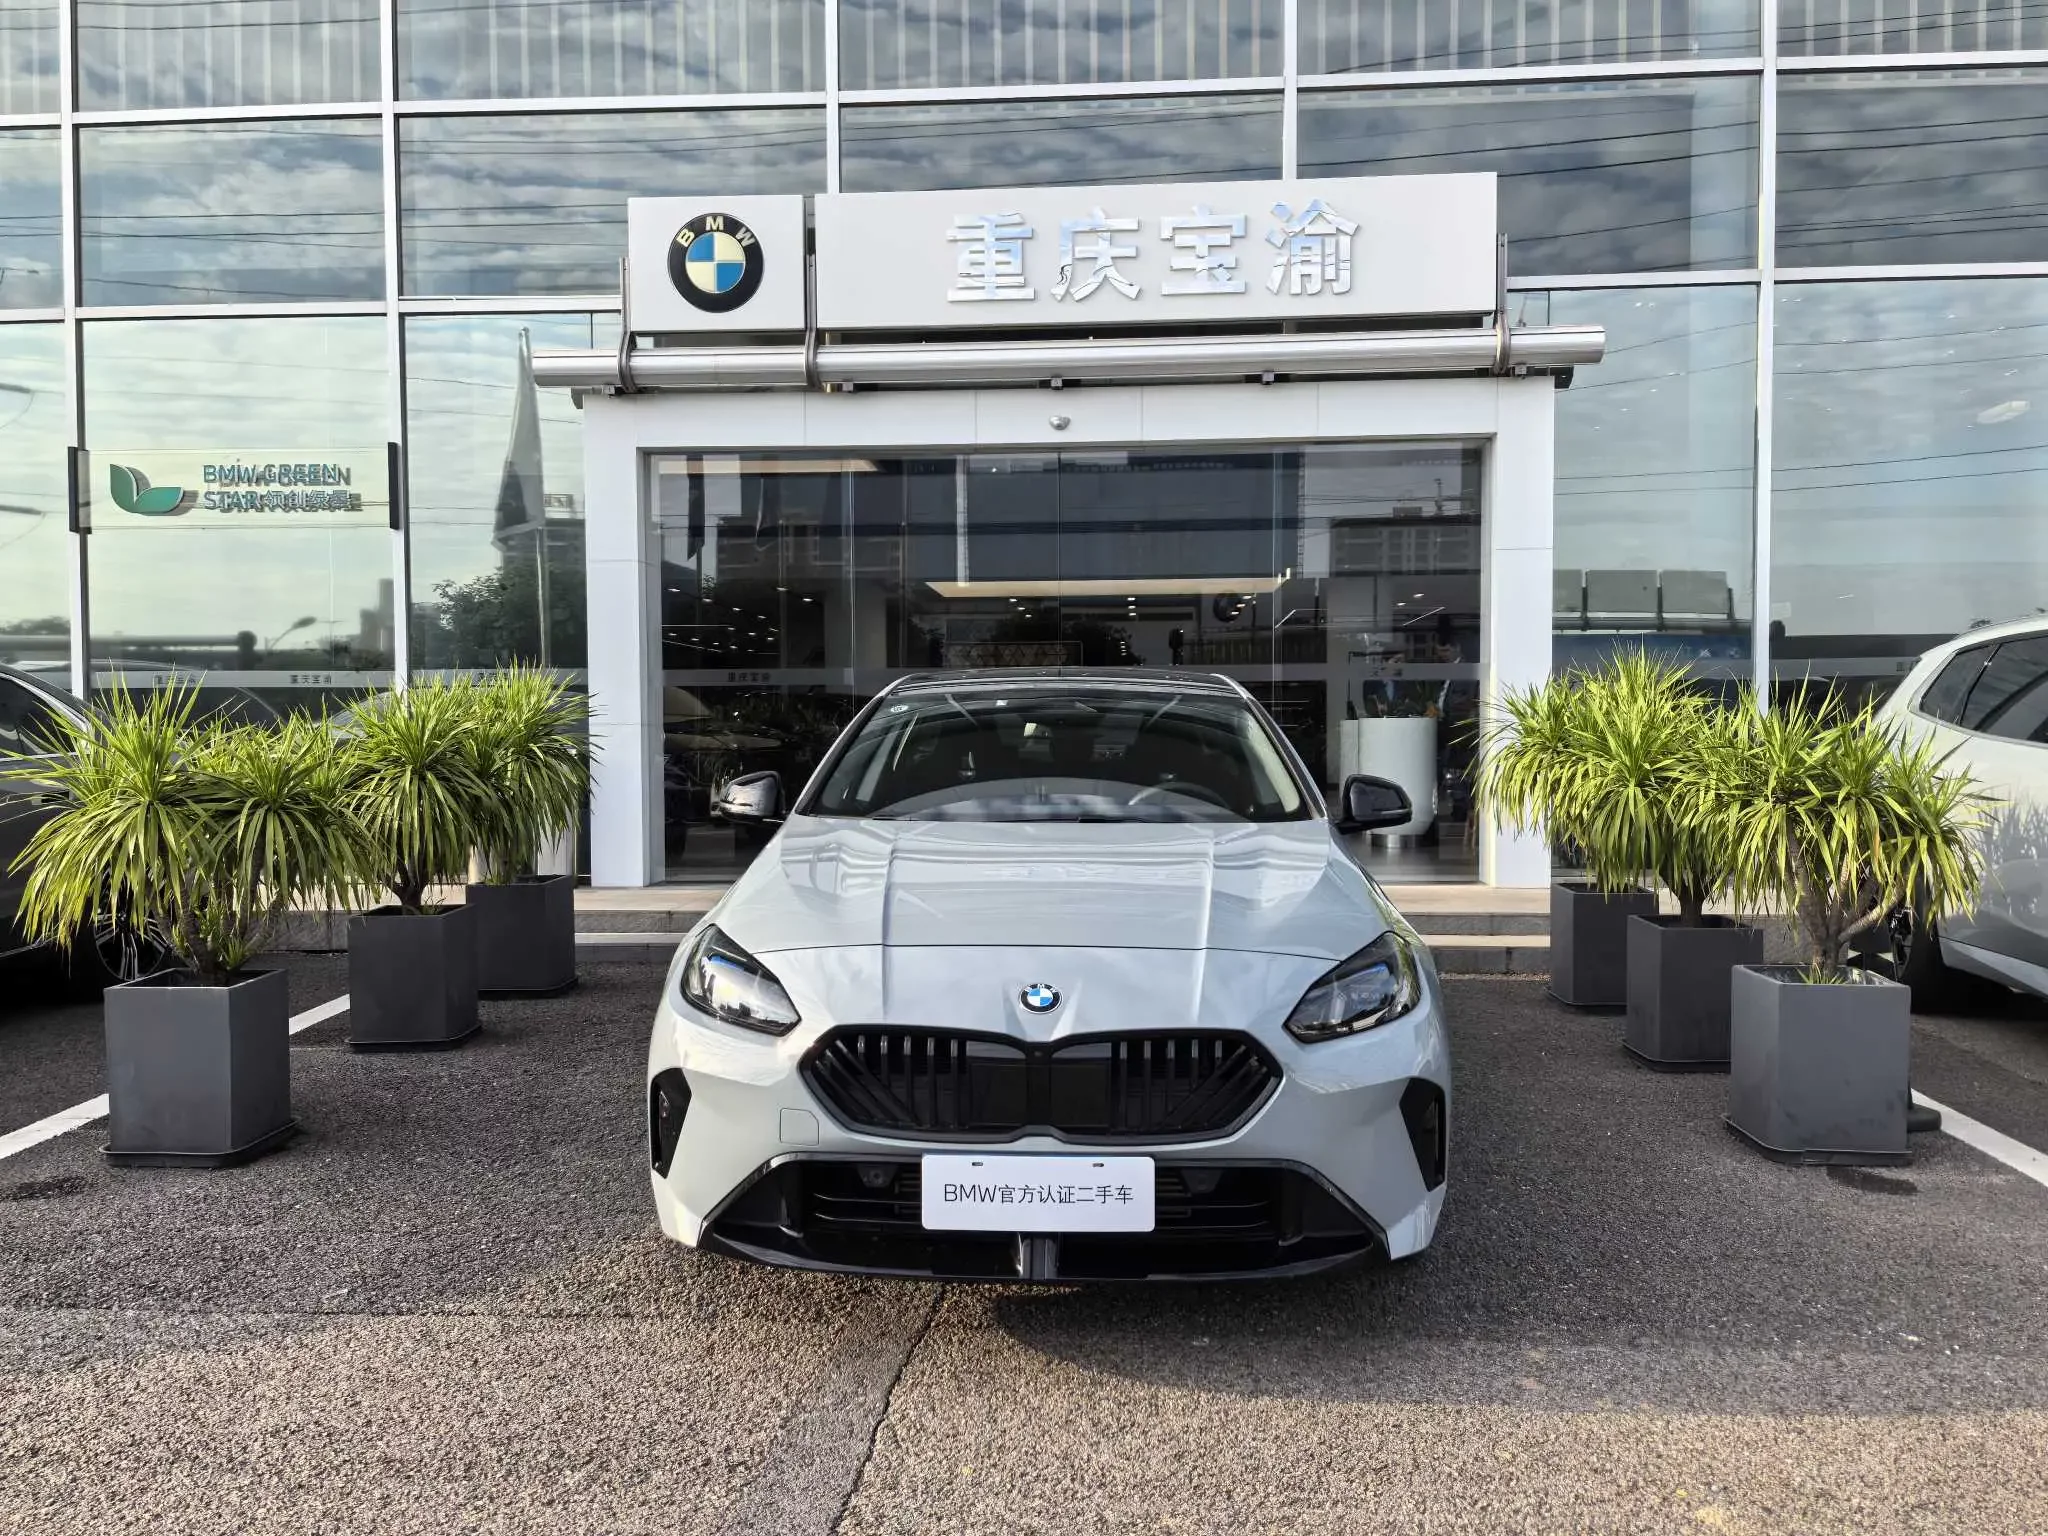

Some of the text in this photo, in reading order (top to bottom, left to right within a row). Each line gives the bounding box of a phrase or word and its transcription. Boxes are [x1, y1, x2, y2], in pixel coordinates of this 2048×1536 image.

[676, 215, 756, 248] BMW
[946, 199, 1361, 302] 重庆宝渝
[203, 463, 339, 484] BMW GREEN
[944, 1183, 1134, 1205] BMW官方认证二手车
